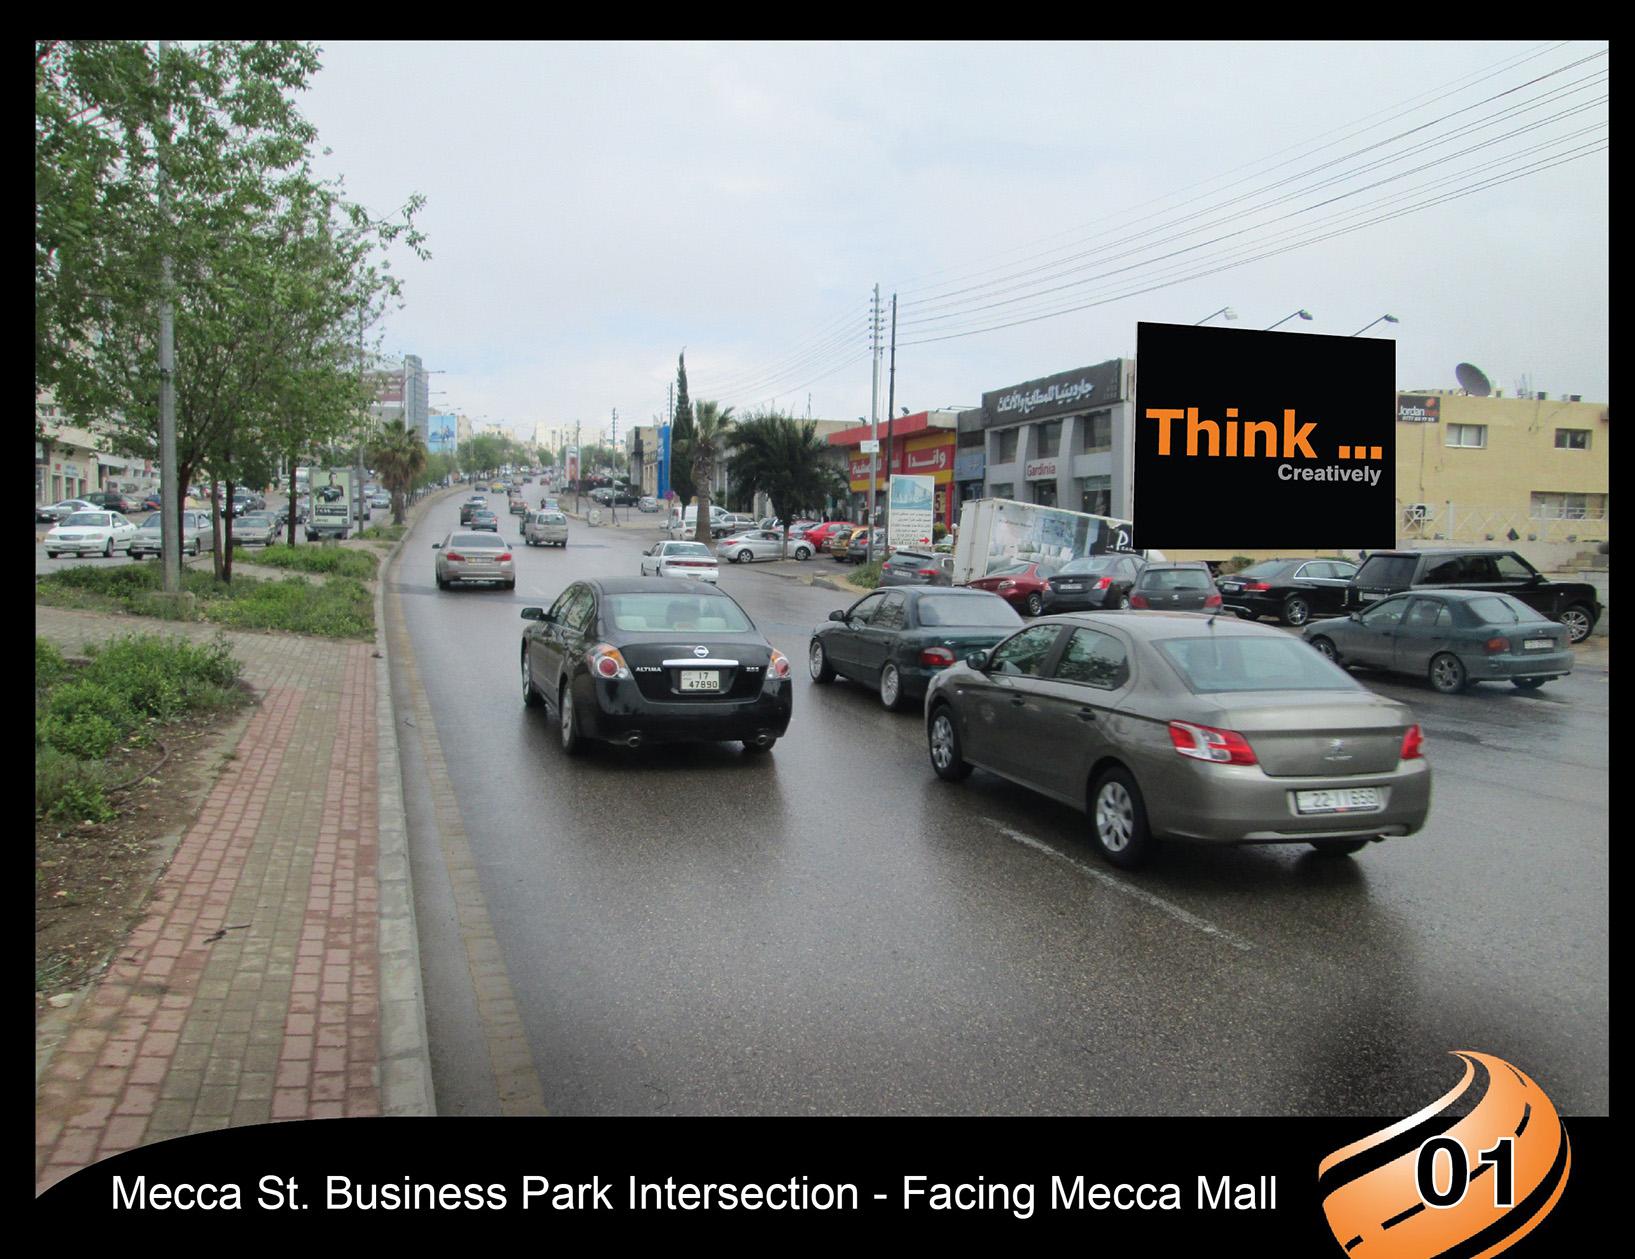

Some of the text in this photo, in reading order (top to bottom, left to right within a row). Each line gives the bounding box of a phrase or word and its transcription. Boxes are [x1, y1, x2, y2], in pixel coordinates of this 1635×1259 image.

[1146, 408, 1318, 459] Think
[1026, 462, 1056, 476] Gardinia
[1277, 464, 1382, 486] Creatively
[698, 672, 709, 680] 17
[688, 680, 718, 689] 47890
